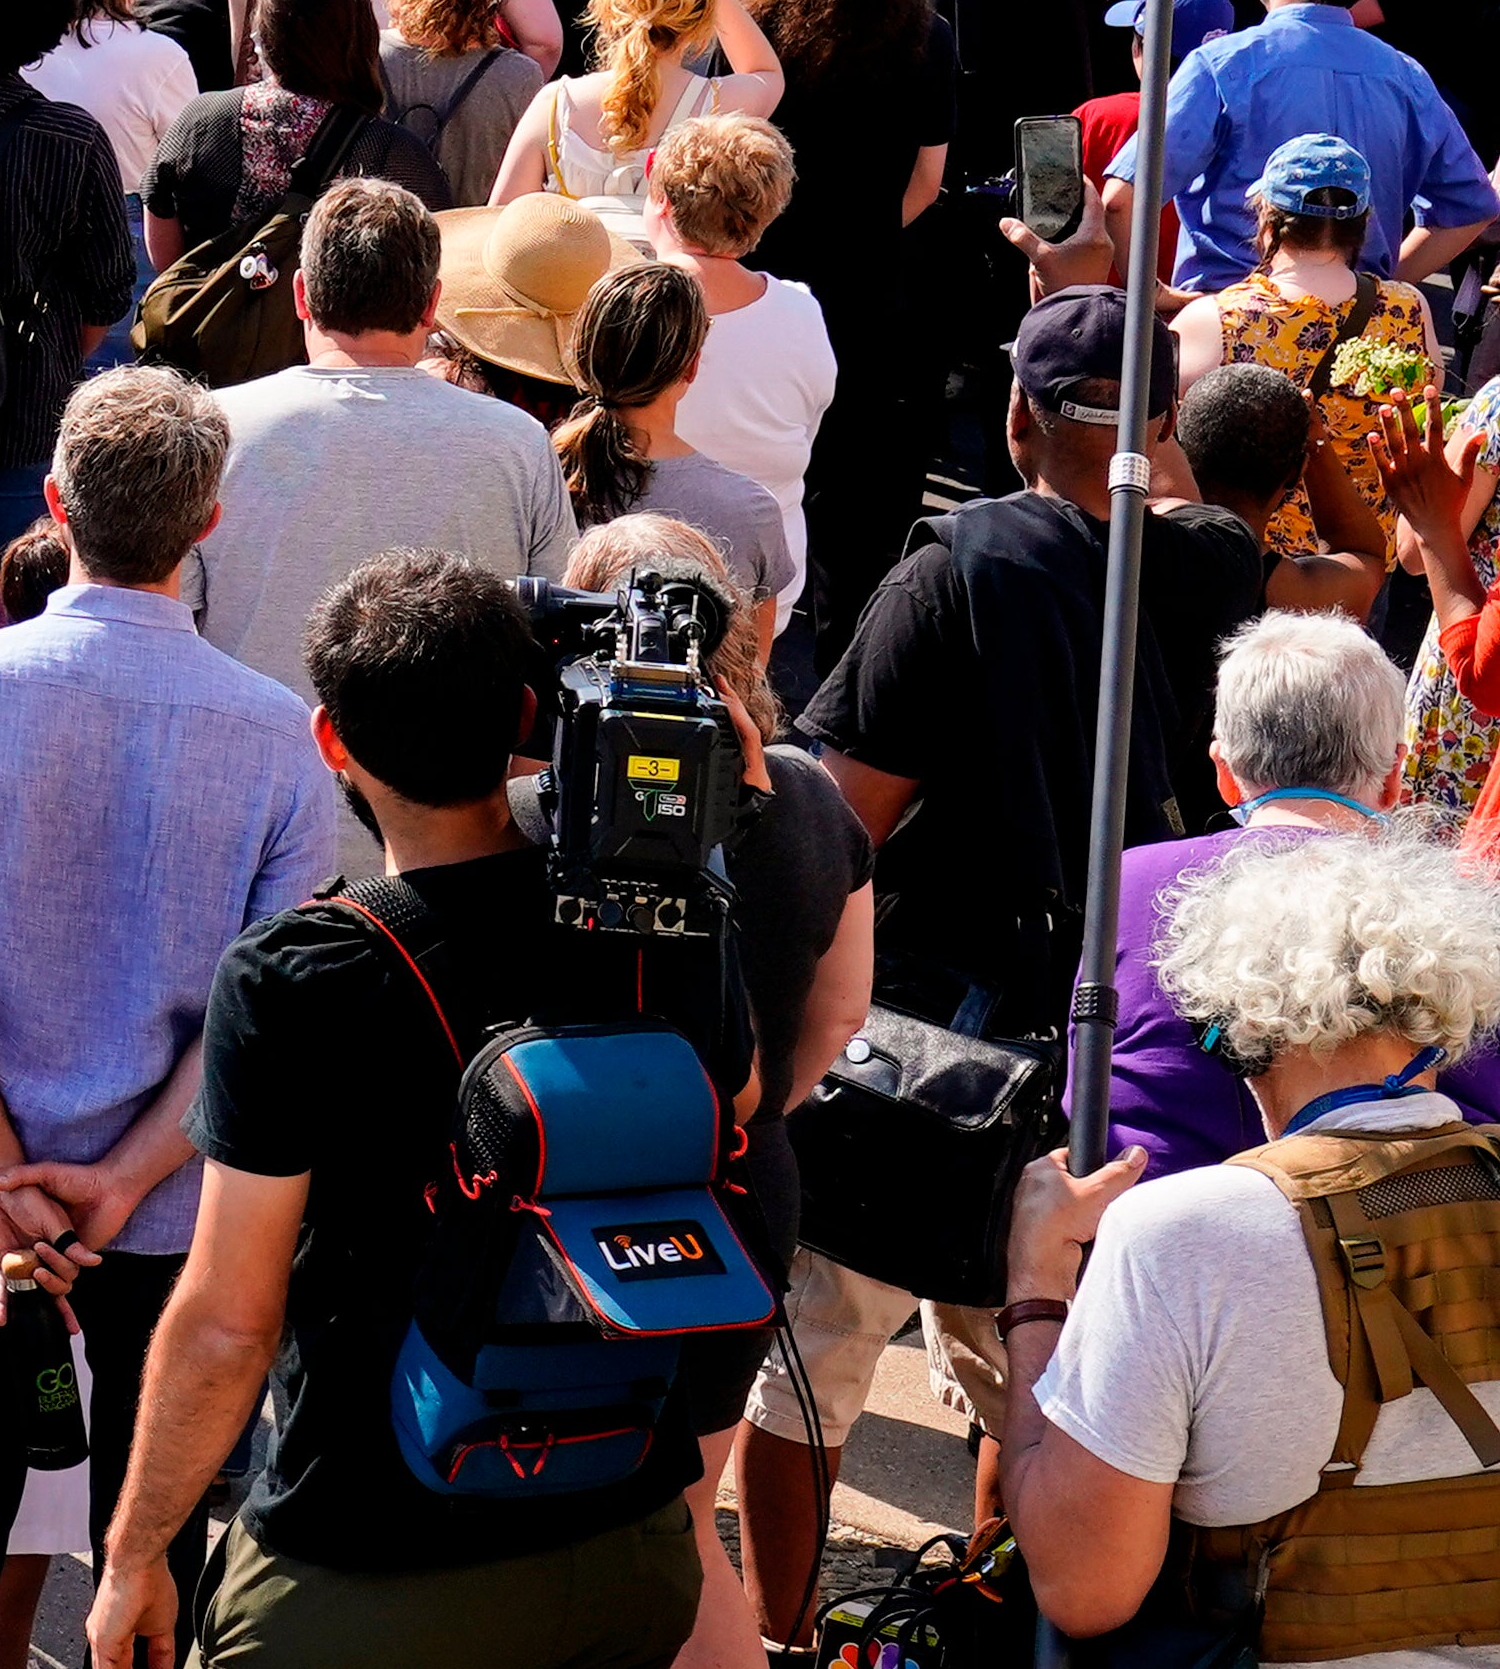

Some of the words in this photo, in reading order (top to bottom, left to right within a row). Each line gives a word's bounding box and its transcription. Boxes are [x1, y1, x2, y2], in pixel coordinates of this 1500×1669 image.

[657, 803, 686, 817] ISO
[598, 1233, 704, 1271] LiveU
[36, 1362, 73, 1394] GO
